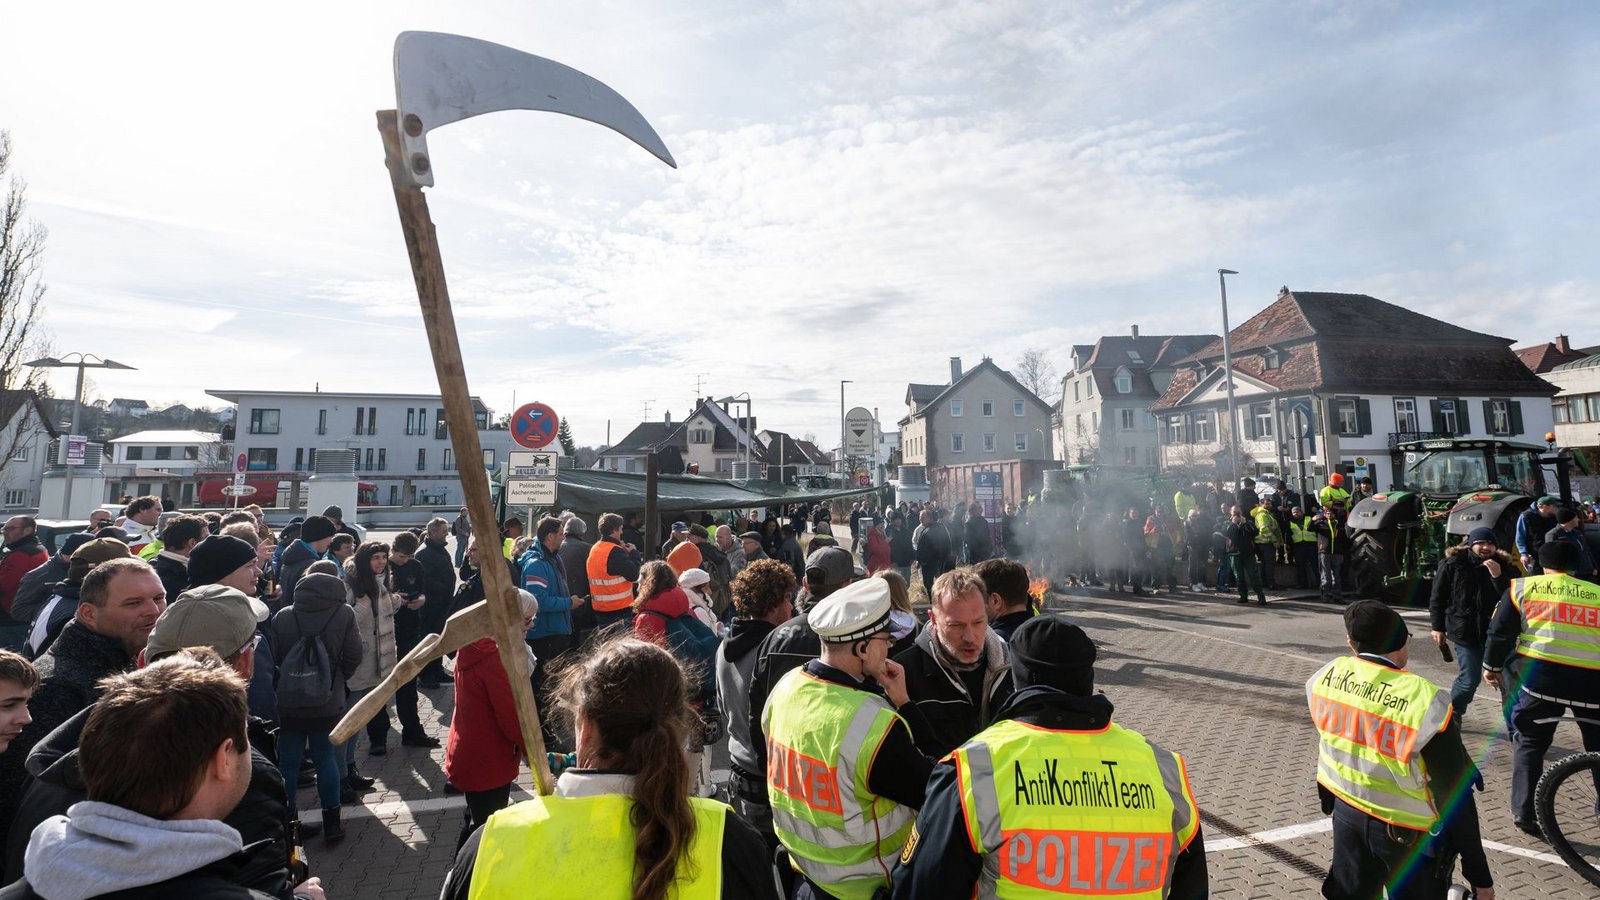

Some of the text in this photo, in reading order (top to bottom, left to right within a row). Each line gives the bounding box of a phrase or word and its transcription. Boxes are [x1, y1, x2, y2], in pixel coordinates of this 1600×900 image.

[1531, 581, 1598, 600] AntiKonfliktTeam
[1322, 666, 1409, 713] AntiKonfliktTeam
[1315, 700, 1408, 760] POLIZEI
[1014, 759, 1156, 810] AntiKonfliktTeam
[1008, 832, 1166, 891] POLIZEI
